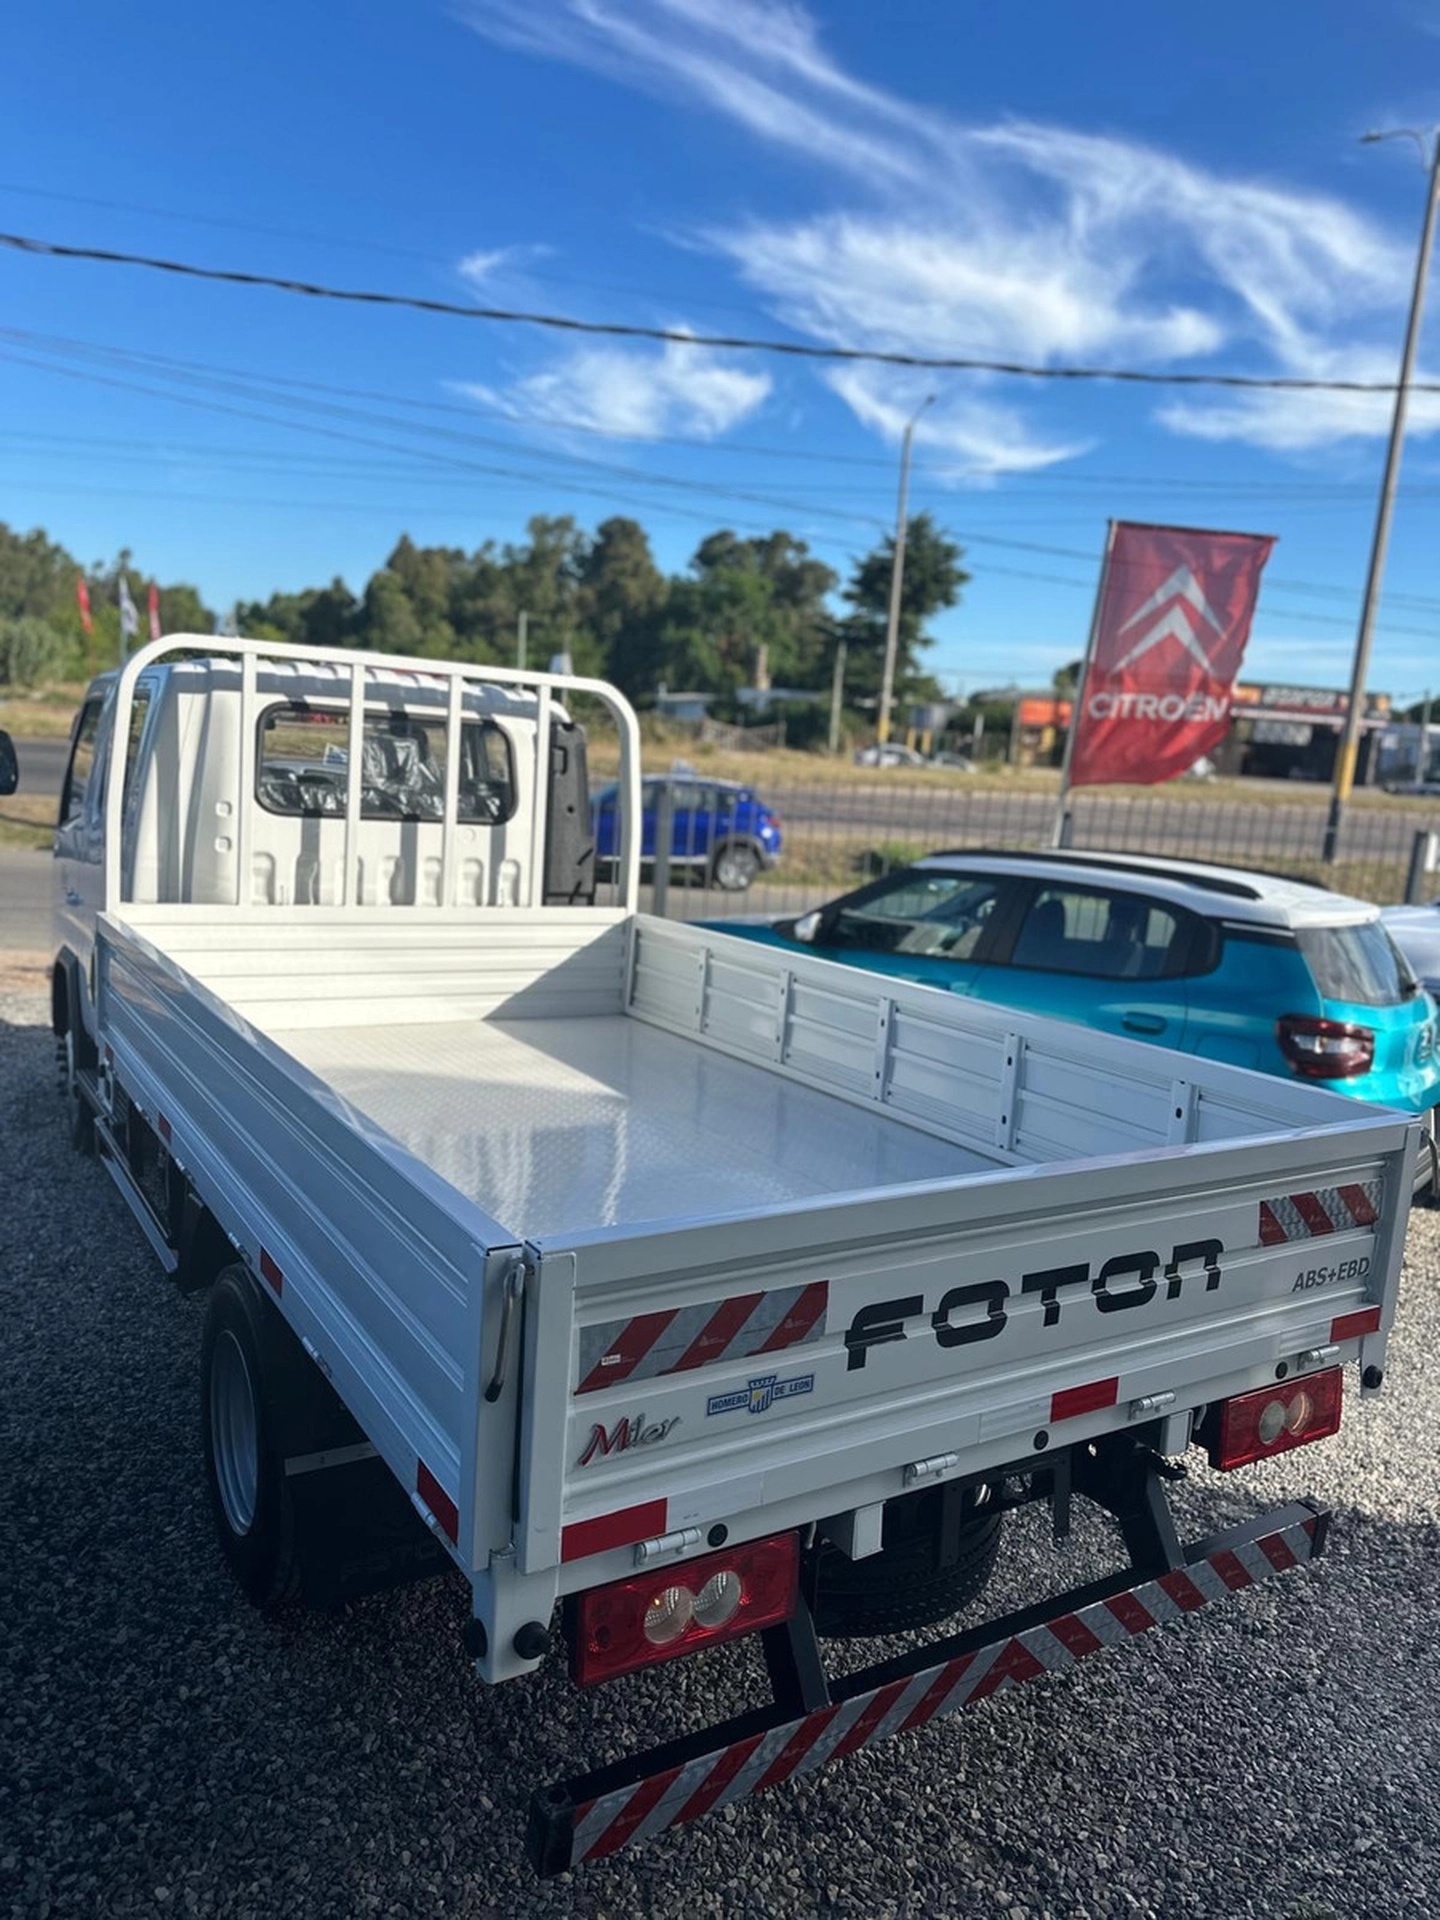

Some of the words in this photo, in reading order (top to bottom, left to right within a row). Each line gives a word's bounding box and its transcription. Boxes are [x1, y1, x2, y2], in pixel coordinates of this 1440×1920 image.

[1291, 1256, 1370, 1293] ABS+EBD
[844, 1237, 1224, 1371] FOTON
[710, 1393, 749, 1411] HOMERO
[774, 1385, 786, 1396] DE
